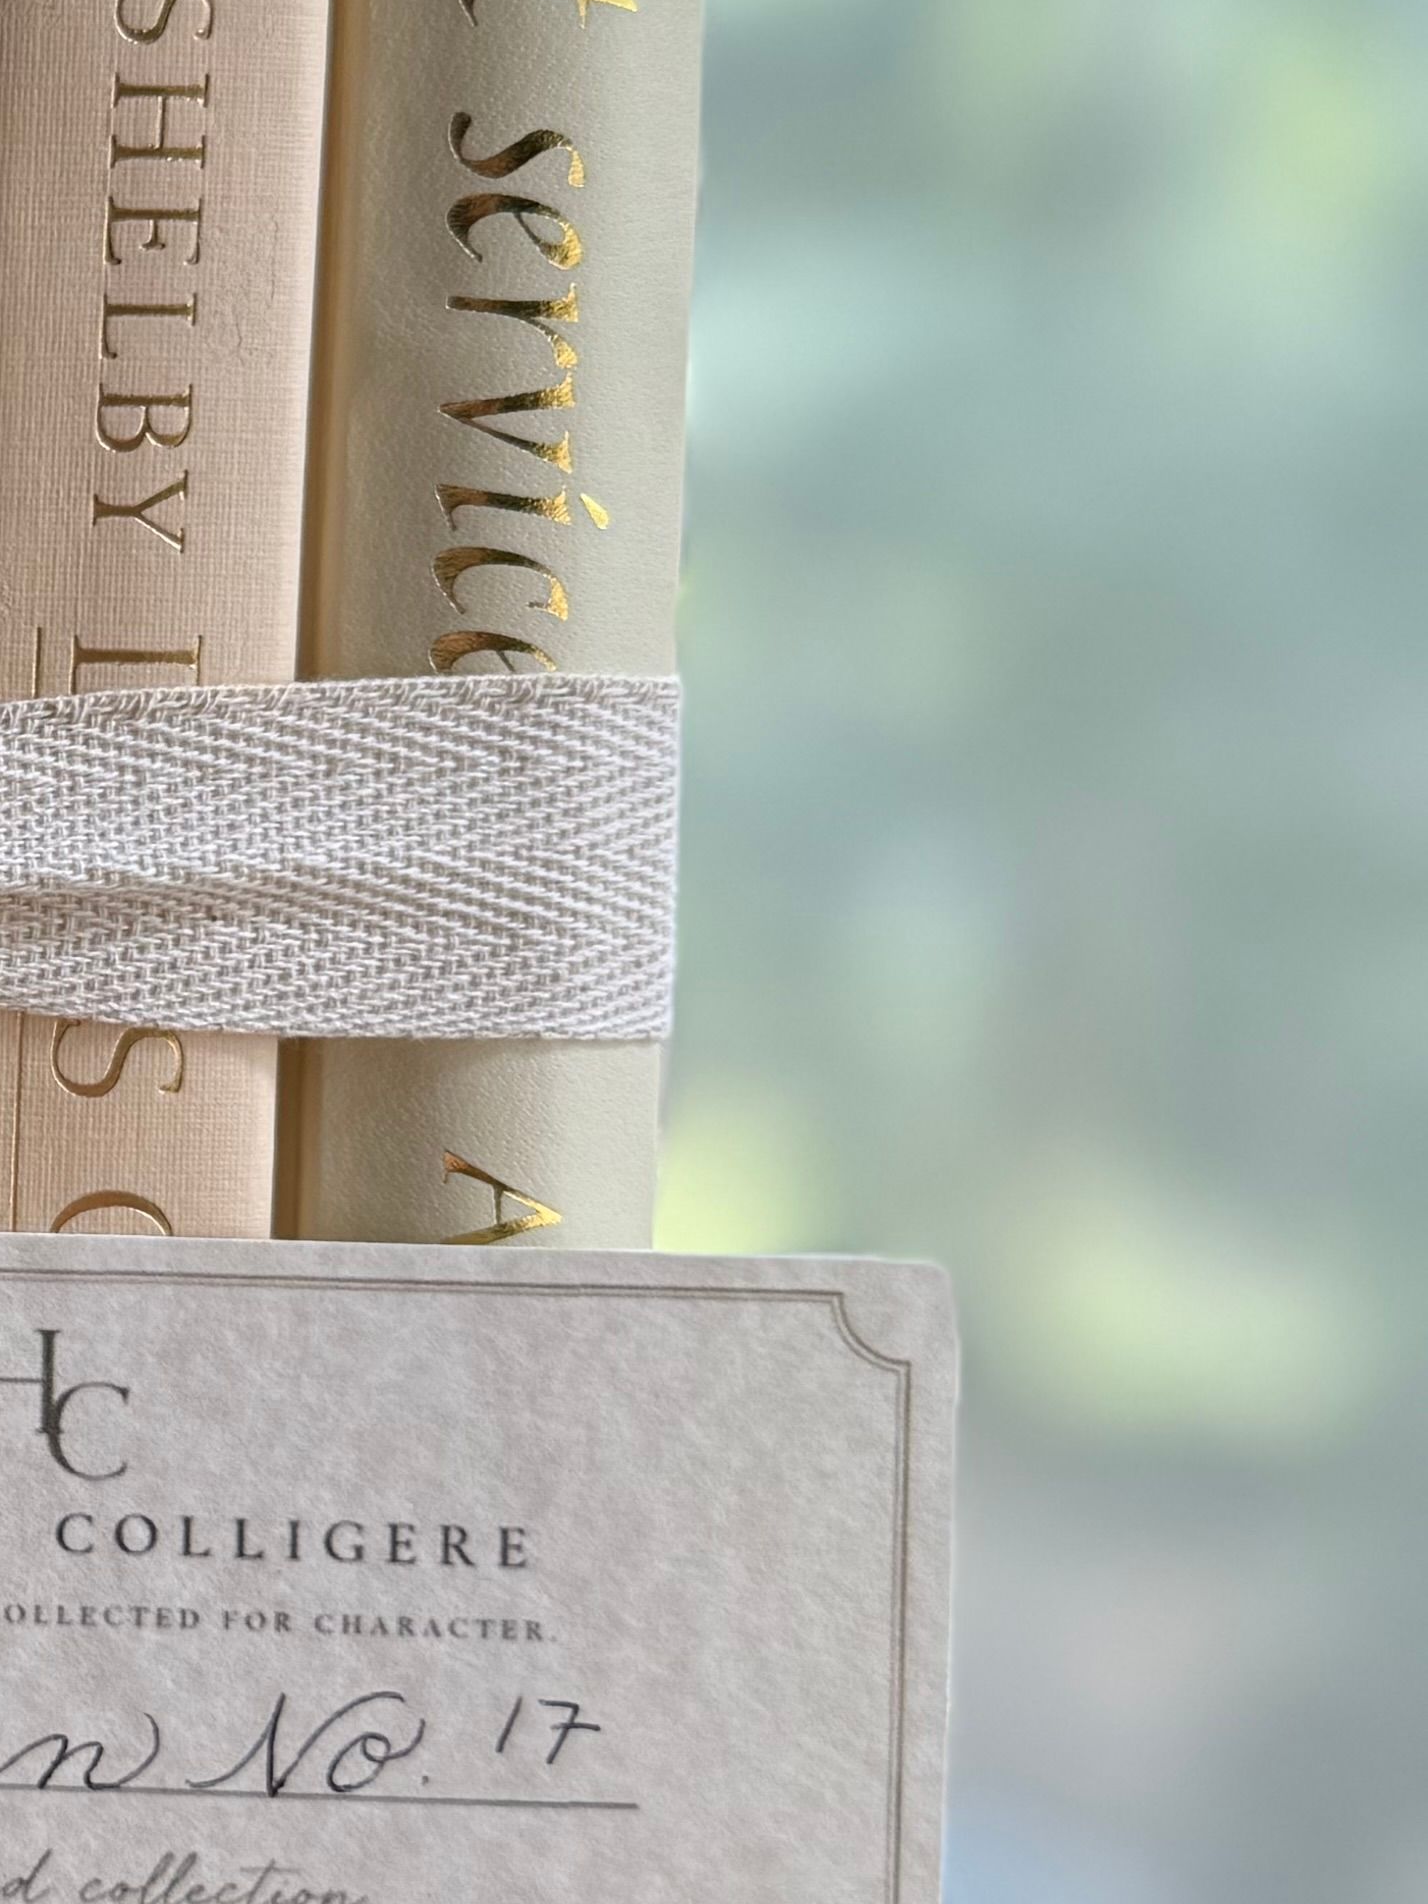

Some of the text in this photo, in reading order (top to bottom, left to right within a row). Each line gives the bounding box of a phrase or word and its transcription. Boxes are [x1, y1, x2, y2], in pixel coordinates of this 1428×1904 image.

[55, 1512, 528, 1570] COLLIGERE
[222, 1608, 293, 1634] FOR
[188, 1690, 432, 1797] No.
[495, 1698, 601, 1766] 17
